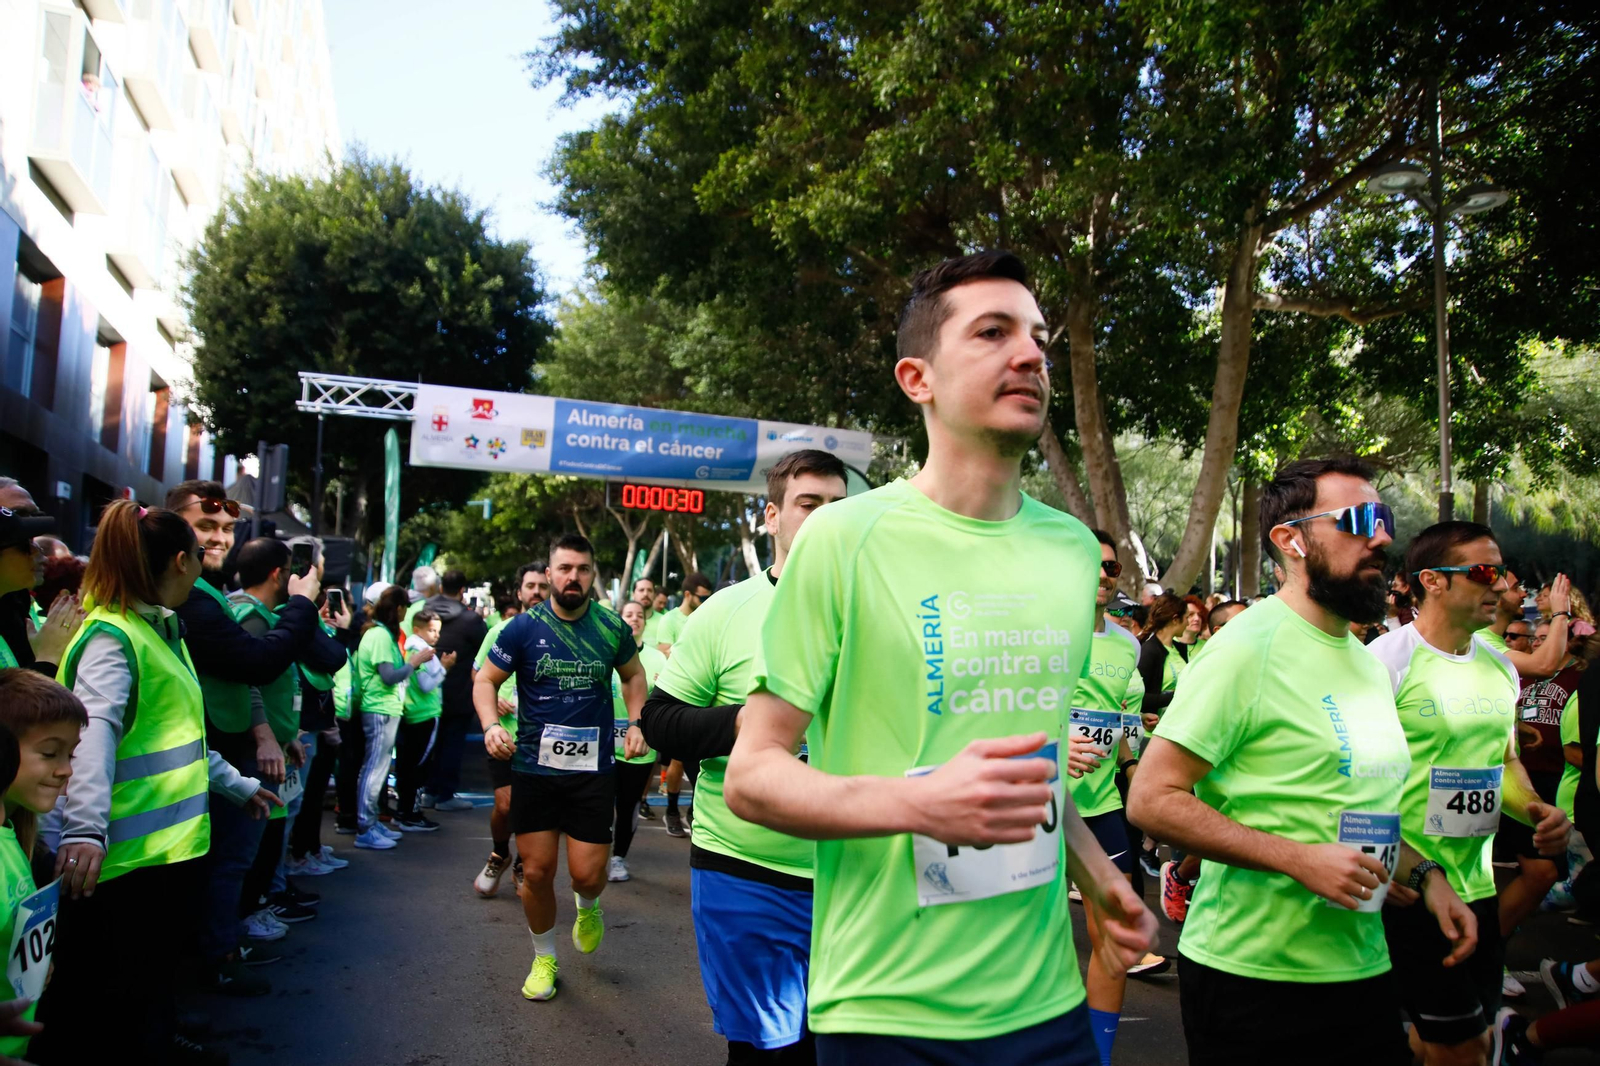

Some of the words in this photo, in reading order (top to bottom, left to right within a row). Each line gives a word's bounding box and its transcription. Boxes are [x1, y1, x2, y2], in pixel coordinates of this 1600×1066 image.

[567, 408, 644, 432] Almería
[650, 420, 672, 433] en
[677, 422, 747, 442] marcha
[566, 432, 631, 453] contra
[635, 437, 654, 454] el
[658, 440, 724, 460] cáncer
[949, 626, 978, 649] En
[984, 623, 1071, 648] marcha
[915, 593, 944, 716] ALMERÍA
[951, 650, 1041, 678] contra
[1047, 649, 1070, 674] el
[552, 741, 589, 757] 624
[1322, 694, 1352, 778] ALMERÍA
[1446, 790, 1496, 815] 488
[1343, 826, 1367, 834] contra
